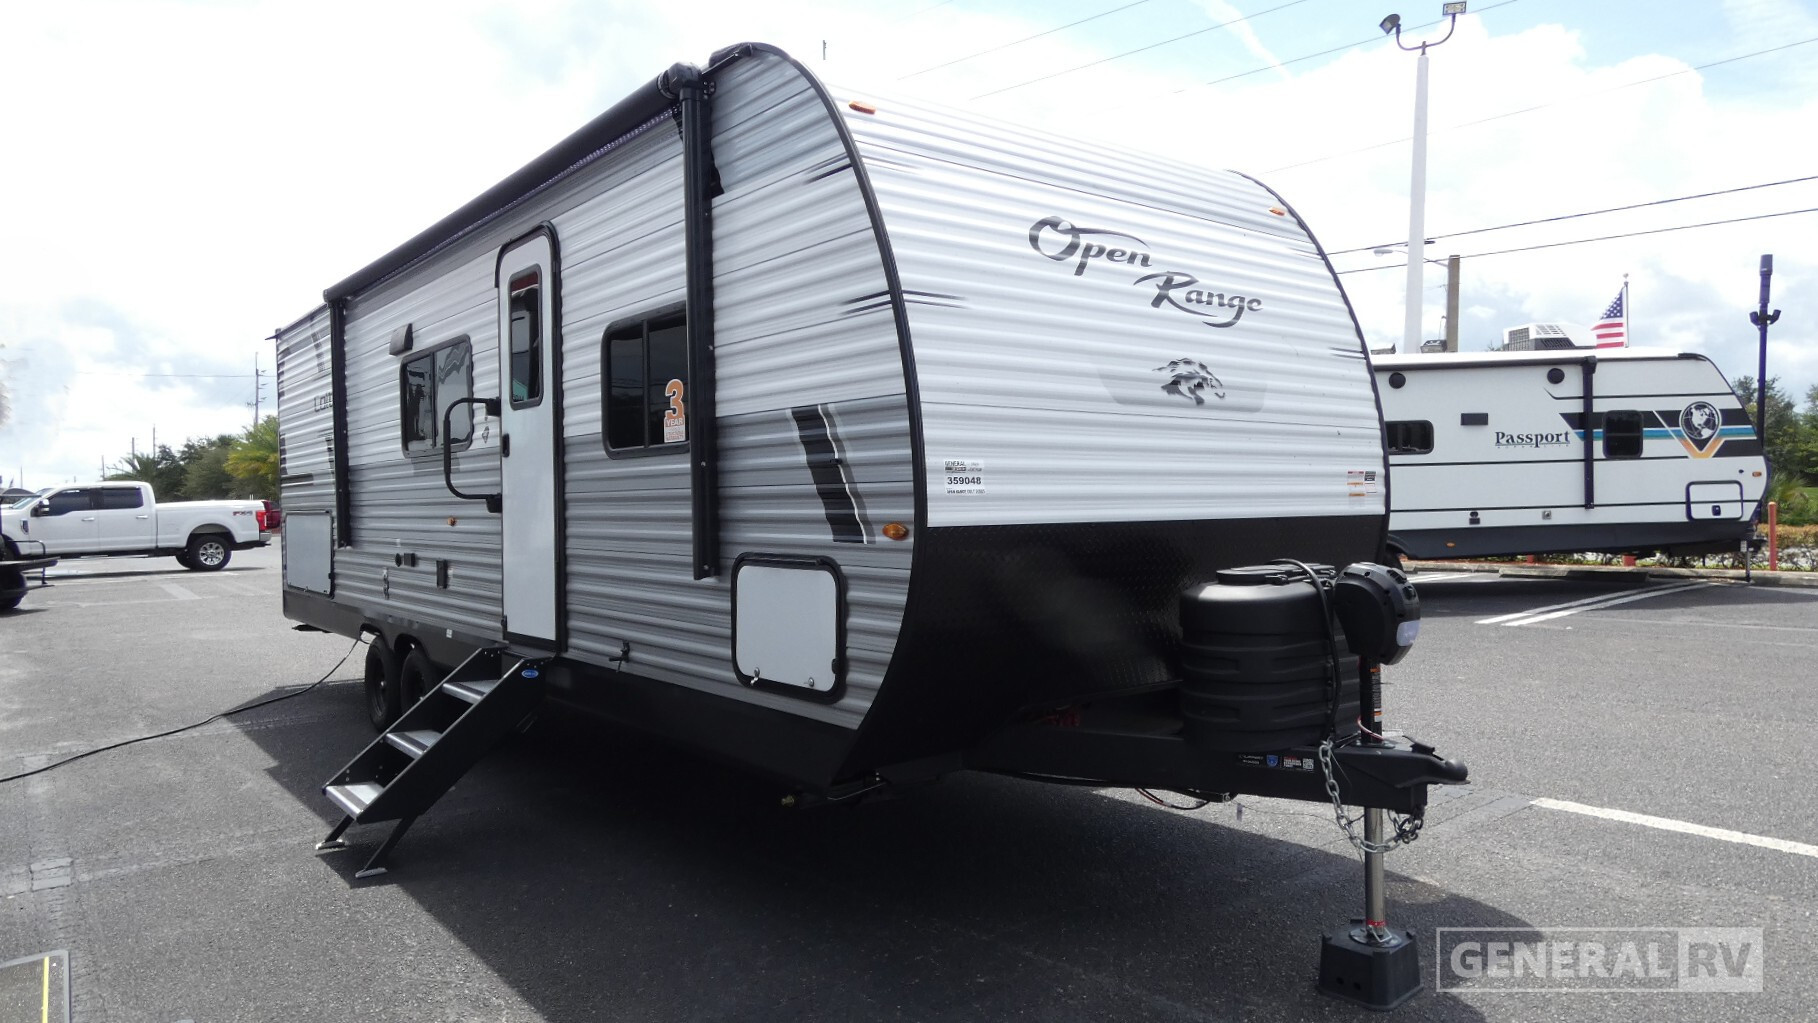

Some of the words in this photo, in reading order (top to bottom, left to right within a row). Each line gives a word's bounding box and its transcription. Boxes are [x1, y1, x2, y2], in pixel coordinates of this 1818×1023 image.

[1028, 216, 1153, 276] Open
[1133, 271, 1264, 328] Range
[665, 379, 684, 419] 3
[666, 418, 683, 427] YEAR
[1495, 431, 1570, 448] Passport
[947, 476, 981, 485] 359048
